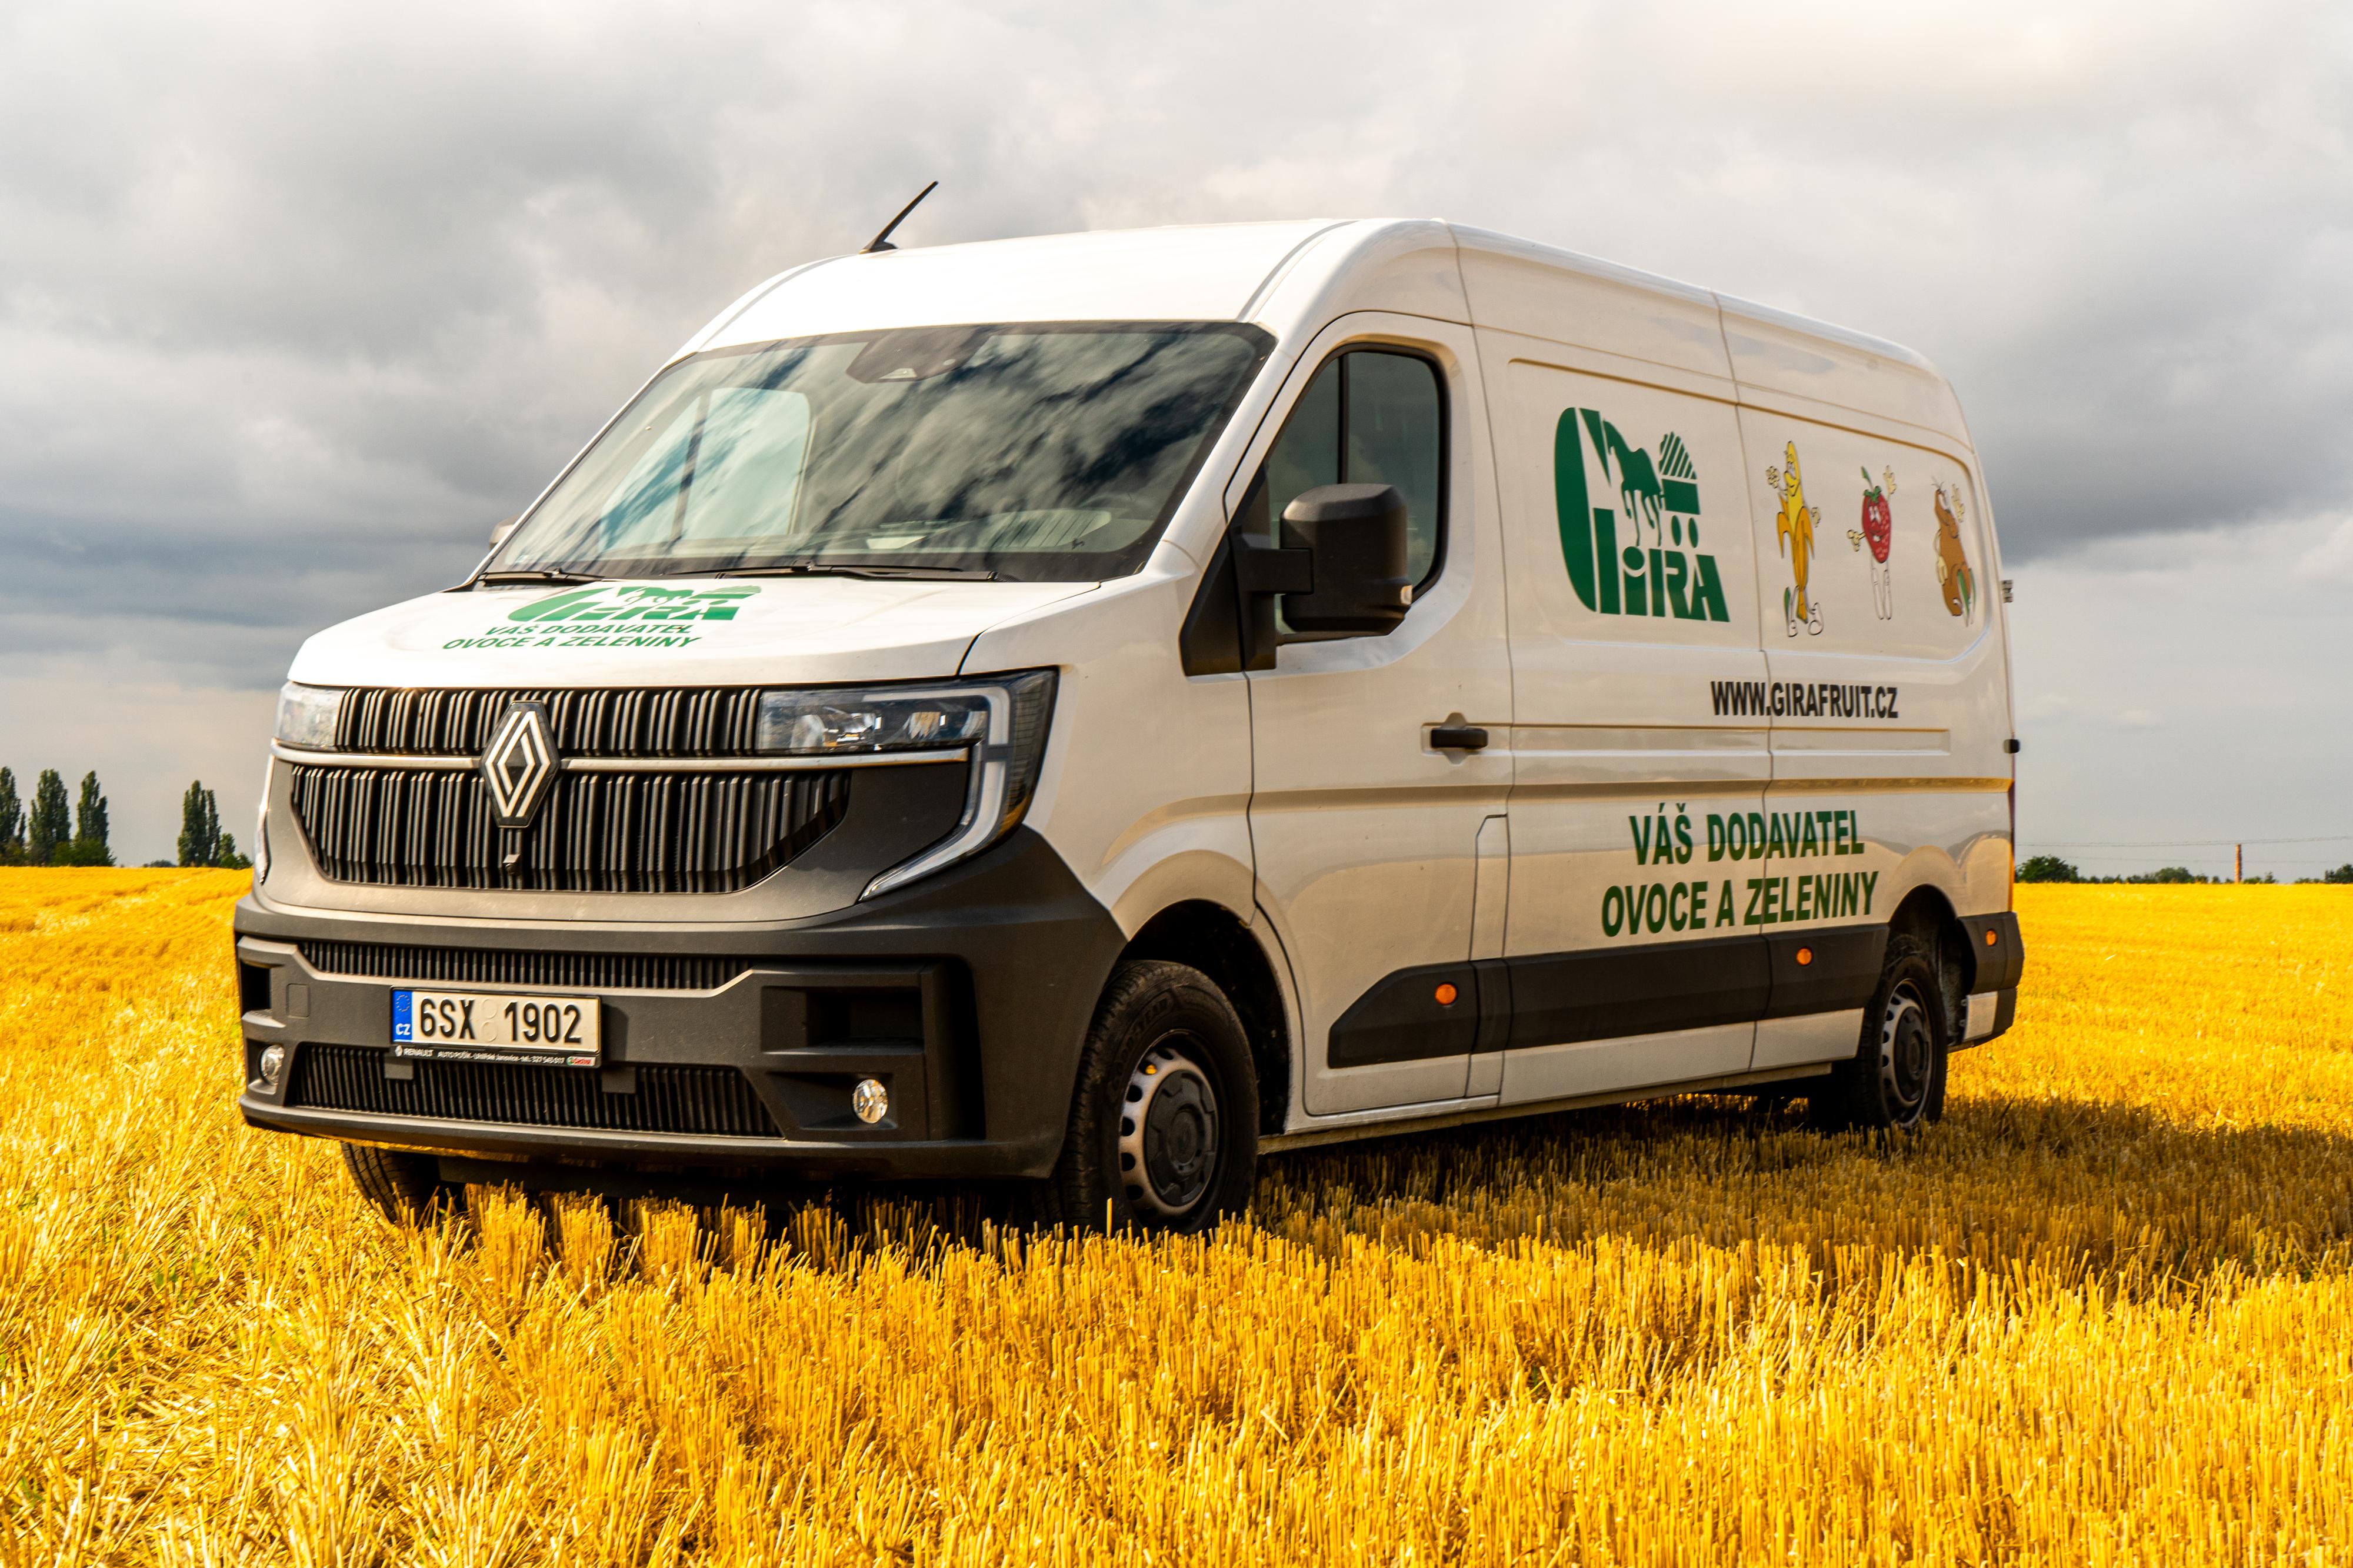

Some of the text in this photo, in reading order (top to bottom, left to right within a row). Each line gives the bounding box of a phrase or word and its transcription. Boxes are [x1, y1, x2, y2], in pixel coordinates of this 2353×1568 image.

[442, 635, 702, 650] OVOCE A ZELENINY
[485, 623, 694, 636] VÁŠ DODAVATEL
[1711, 680, 1899, 719] WWW.GIRAFRUIT.CZ
[1628, 802, 1865, 865] VÁŠ DODAVATEL
[1602, 870, 1879, 938] OVOCE A ZELENINY
[395, 1023, 411, 1036] CZ
[420, 998, 582, 1044] 6SX 1902
[404, 1047, 434, 1057] RENAULT
